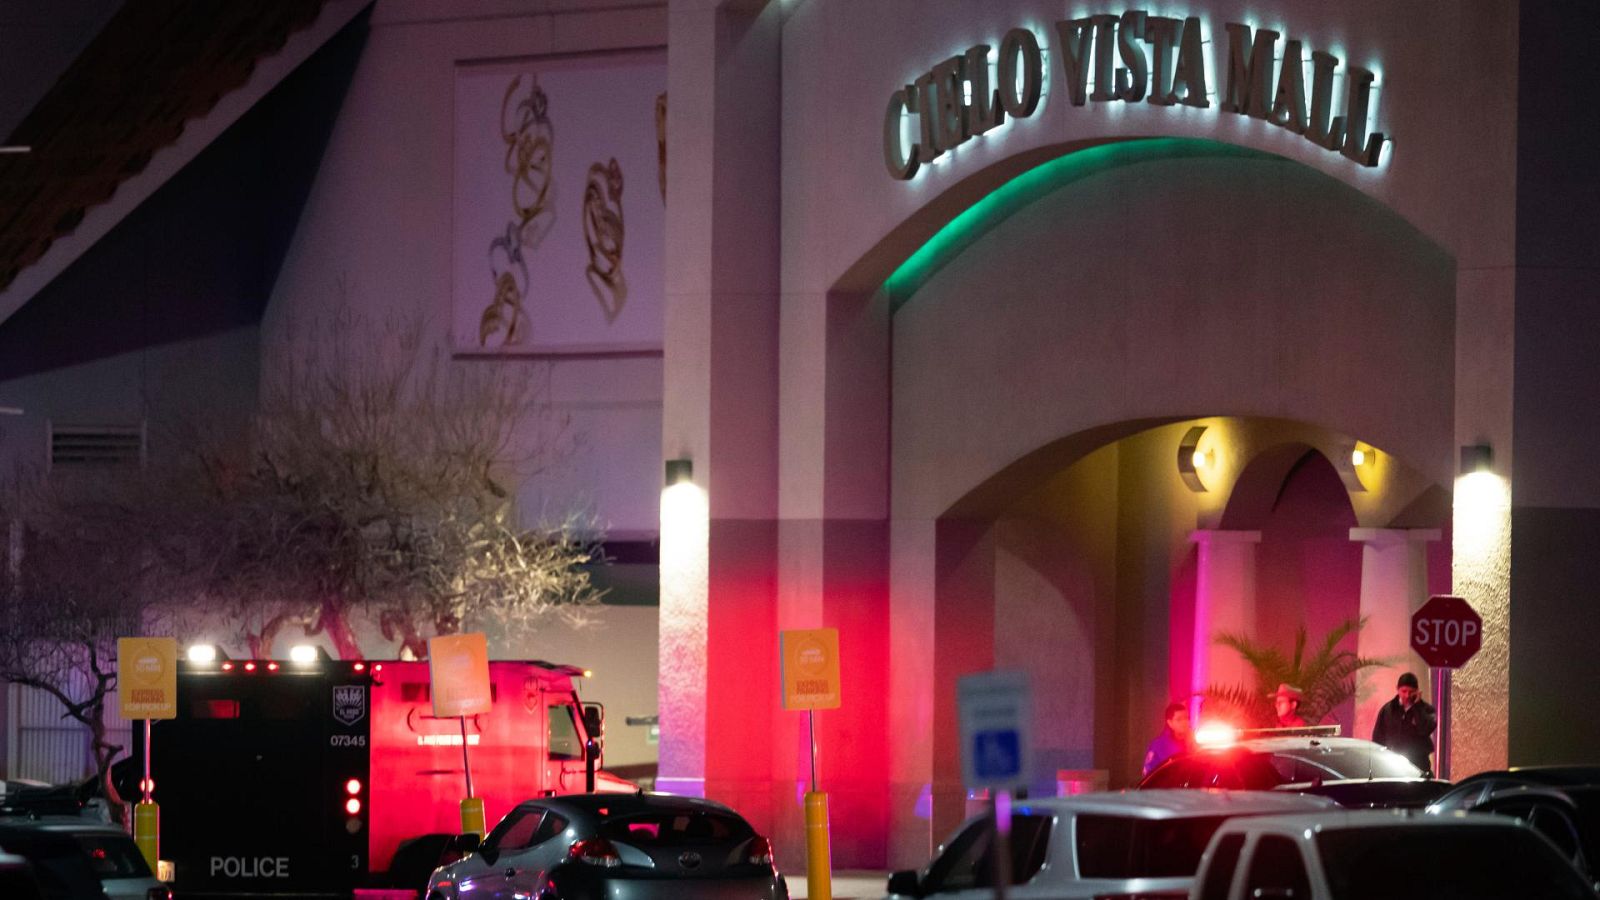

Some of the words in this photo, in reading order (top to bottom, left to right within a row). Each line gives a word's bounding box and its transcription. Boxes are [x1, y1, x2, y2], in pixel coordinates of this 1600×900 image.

[883, 28, 1043, 181] CIELO
[1056, 10, 1210, 108] VISTA
[1221, 22, 1385, 168] MALL
[1415, 618, 1477, 647] STOP
[330, 735, 366, 747] 07345
[210, 857, 290, 877] POLICE
